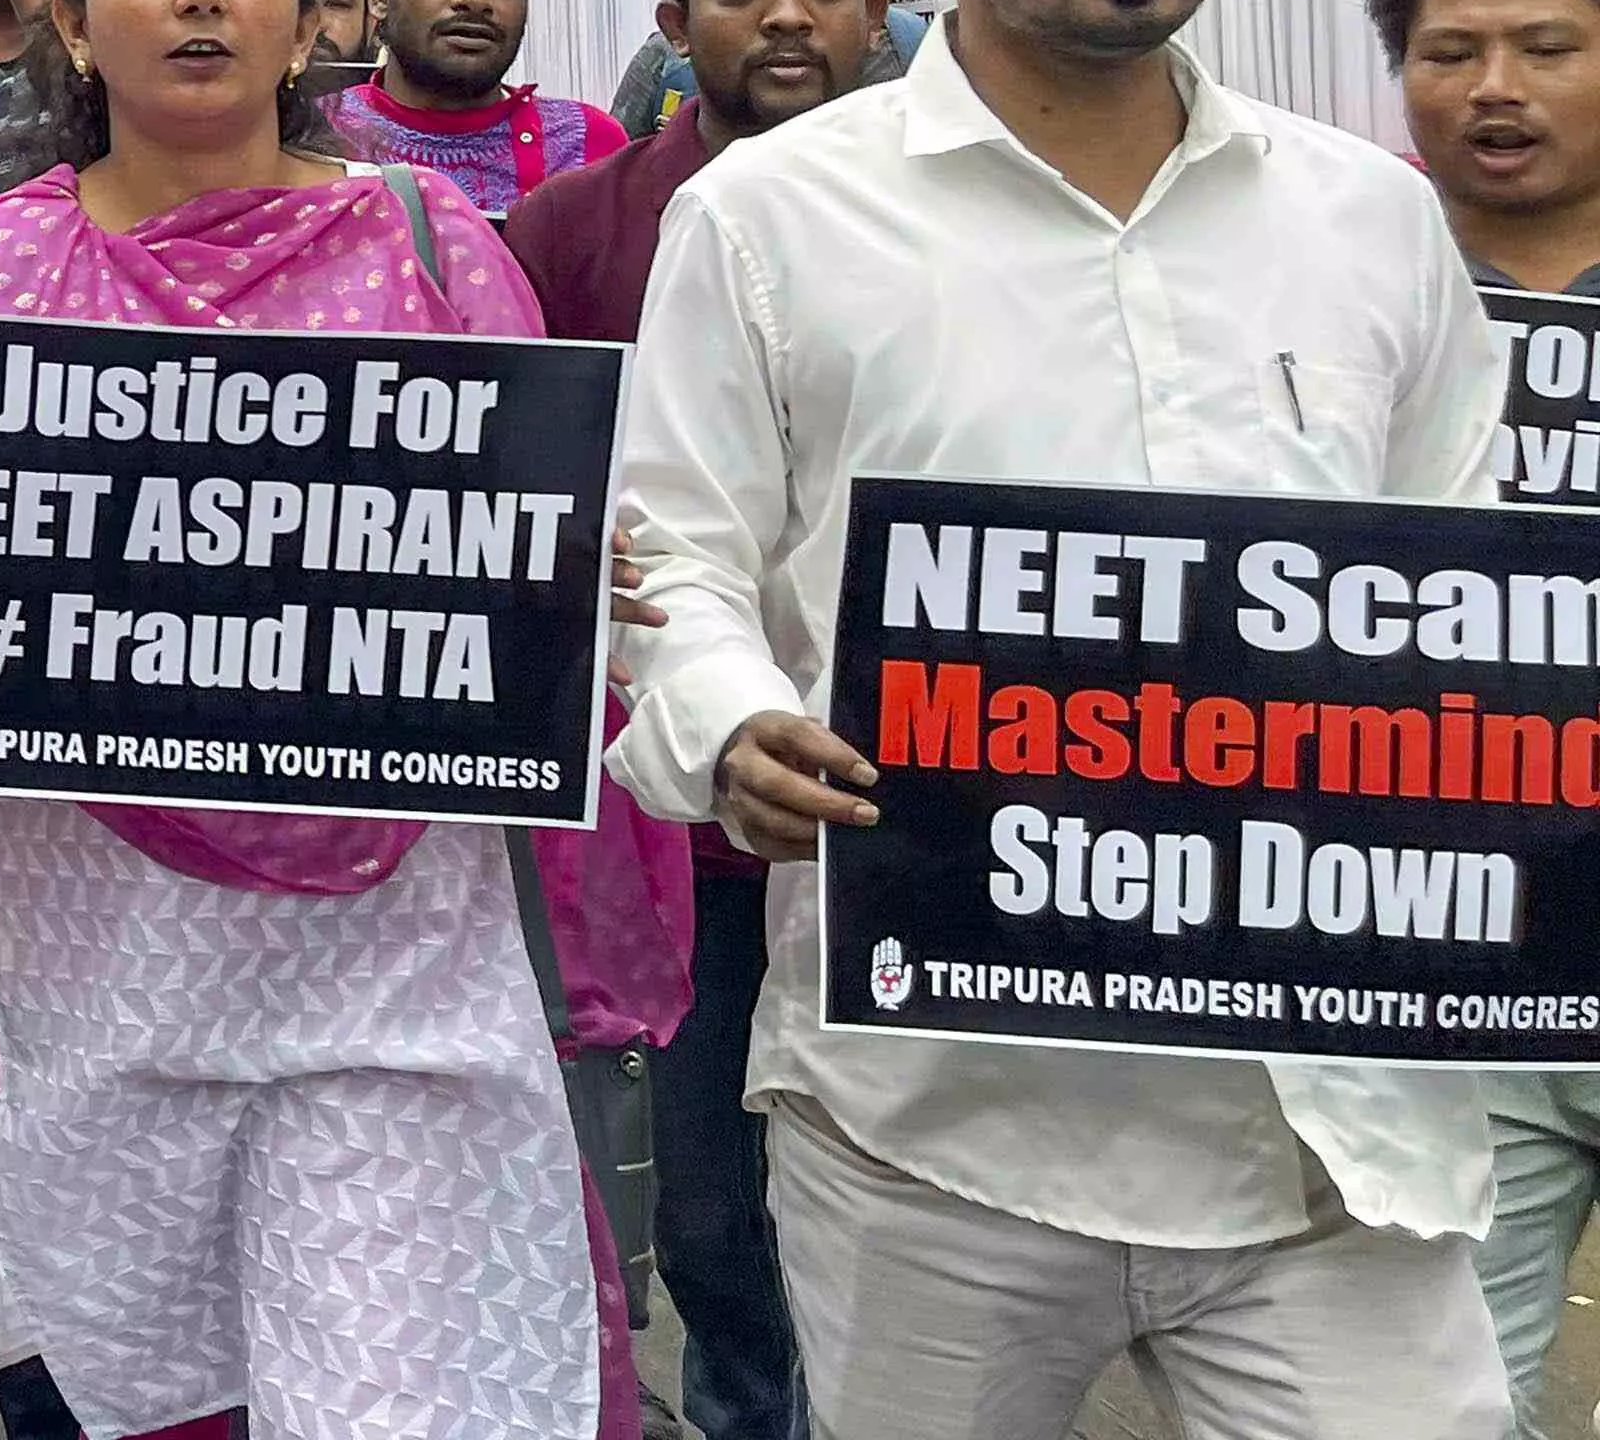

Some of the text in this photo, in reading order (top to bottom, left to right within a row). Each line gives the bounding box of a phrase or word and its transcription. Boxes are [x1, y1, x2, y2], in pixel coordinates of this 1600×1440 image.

[350, 361, 499, 453] For
[124, 477, 574, 580] ASPIRANT
[883, 523, 1600, 666] NEET Scam
[47, 593, 307, 691] Fraud
[328, 607, 494, 702] NTA
[97, 735, 248, 773] PRADESH
[259, 744, 371, 779] YOUTH
[381, 751, 561, 791] CONGRESS
[990, 805, 1516, 943] Step Down
[925, 961, 1093, 1007] TRIPURA
[1105, 974, 1282, 1019] PRADESH
[1294, 986, 1425, 1027] YOUTH
